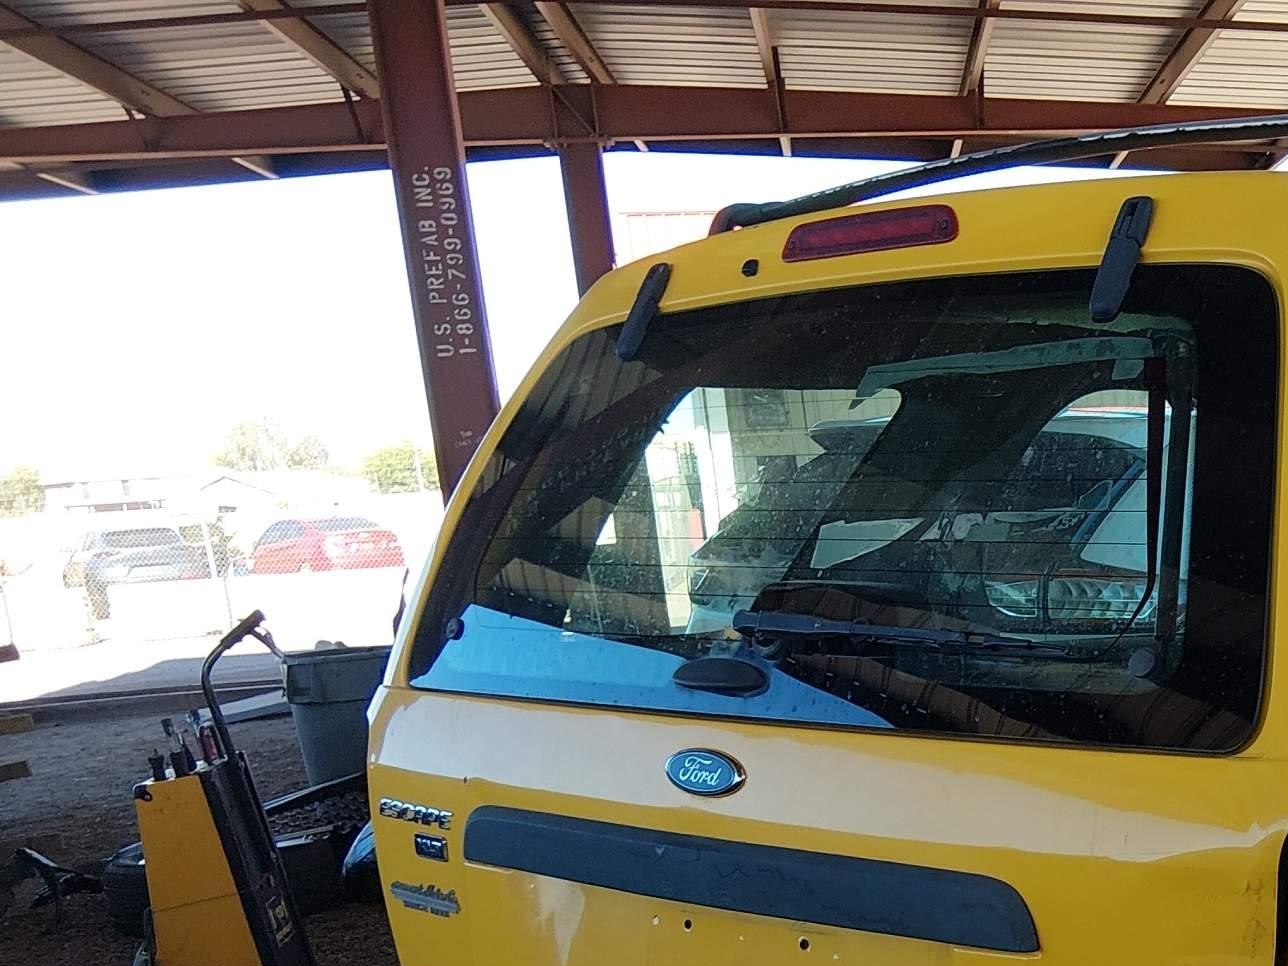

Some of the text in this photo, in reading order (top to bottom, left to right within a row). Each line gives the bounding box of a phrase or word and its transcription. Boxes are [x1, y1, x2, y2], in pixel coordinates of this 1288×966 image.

[412, 165, 455, 358] U.S. PREFAB INC.
[433, 166, 477, 355] 1-866-799-0969
[379, 797, 454, 831] ESCAPE
[679, 756, 722, 787] Ford
